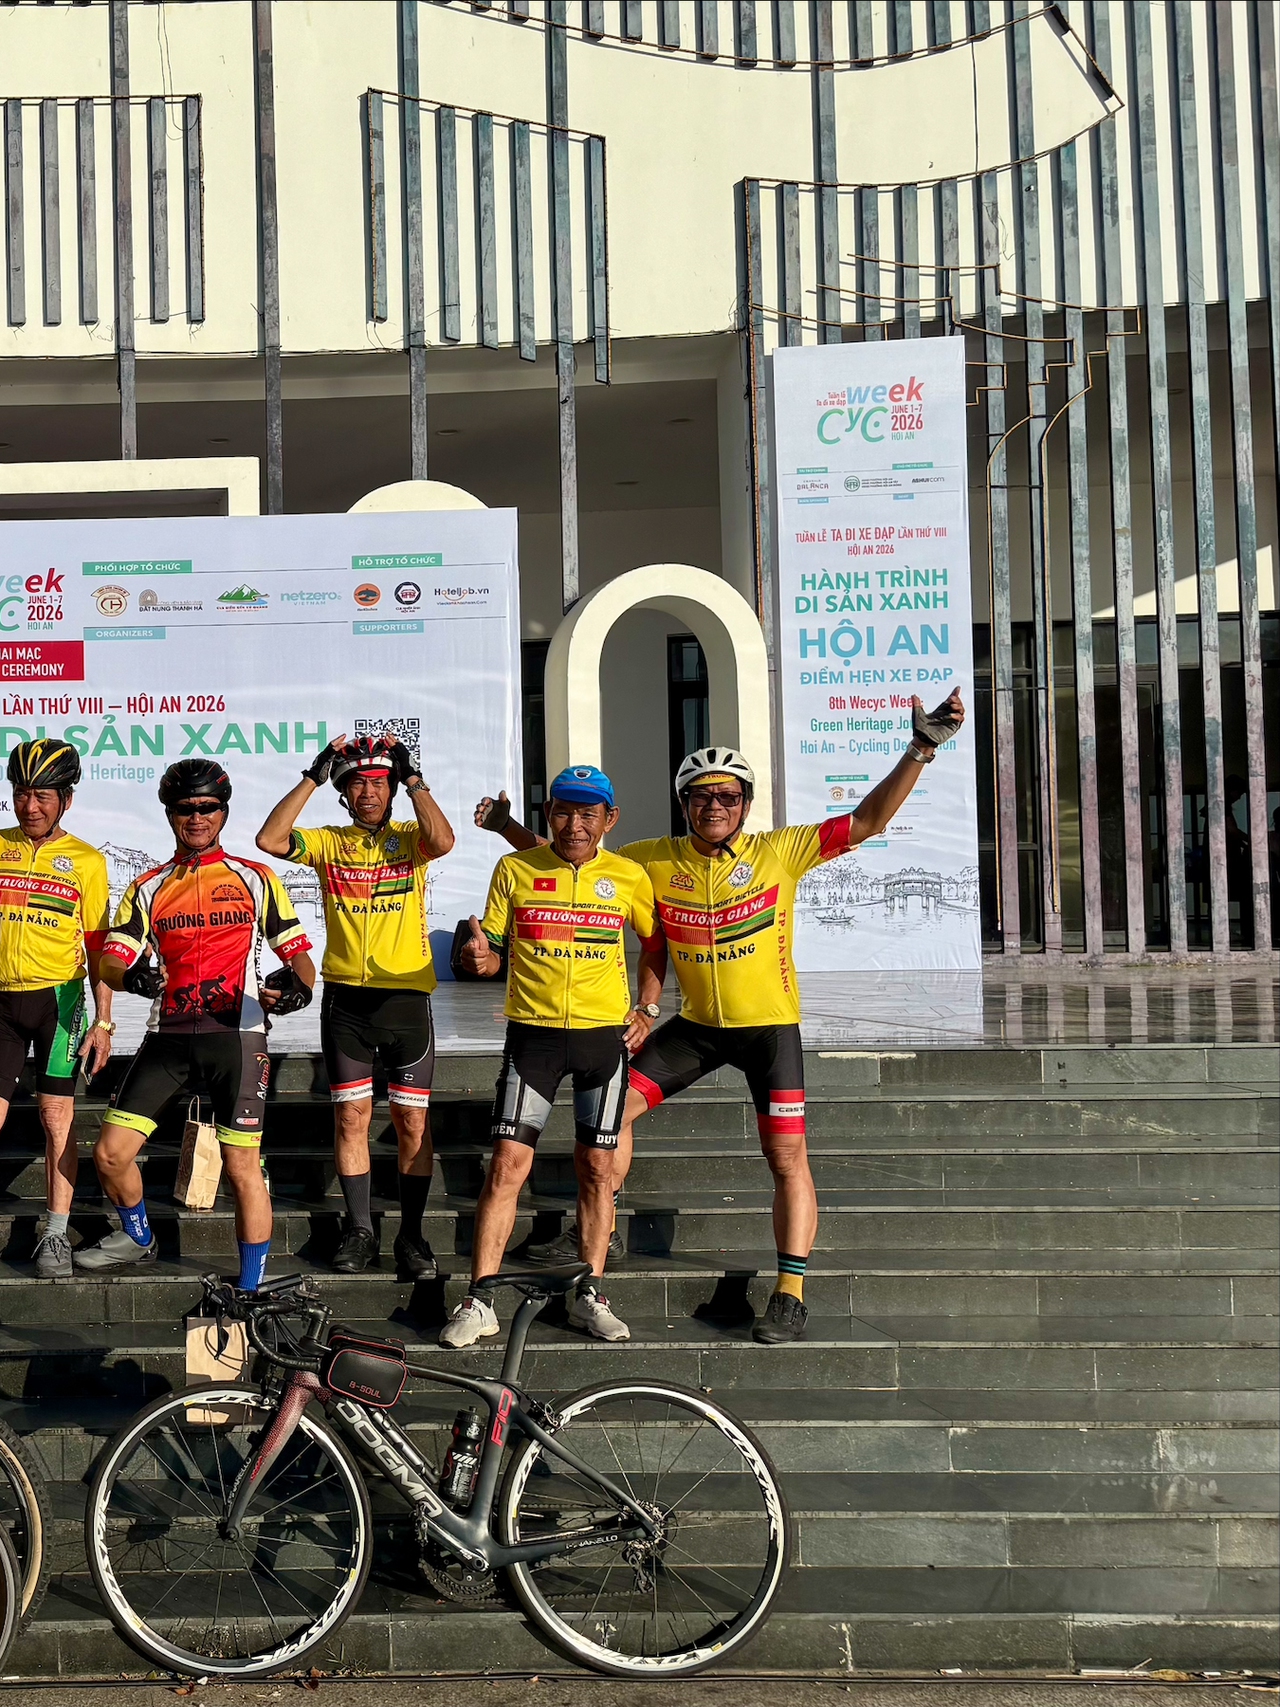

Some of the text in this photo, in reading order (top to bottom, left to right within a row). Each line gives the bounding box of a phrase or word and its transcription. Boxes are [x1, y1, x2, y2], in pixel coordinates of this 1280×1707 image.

[847, 376, 924, 404] week
[891, 414, 923, 431] 2026
[801, 565, 948, 591] HÀNH TRÌNH
[27, 596, 47, 604] JUNE
[795, 589, 948, 614] DI SẢN XANH
[27, 604, 63, 621] 2026
[42, 622, 53, 630] AN
[359, 624, 417, 632] SUPPORTERS
[799, 618, 949, 667] HỘI AN
[16, 647, 42, 662] MẠC
[1, 663, 64, 677] CEREMONY
[799, 666, 953, 687] ĐIỂM HẸN XE ĐẠP
[2, 692, 33, 715] LẦN
[41, 694, 72, 714] THỨ
[77, 697, 104, 714] VIII
[127, 692, 154, 717] HỘI
[159, 696, 181, 713] AN
[187, 694, 226, 713] 2026
[828, 696, 846, 710] 8th
[849, 695, 886, 712] Wecyc
[810, 718, 843, 732] Green
[846, 717, 893, 734] Heritage
[179, 721, 327, 756] XANH
[90, 764, 155, 783] Heritage
[42, 883, 74, 897] GIANG
[536, 910, 621, 927] TRƯỜNG GIANG
[674, 896, 766, 925] TRƯỜNG GIANG
[155, 910, 252, 932] TRƯỜNG GIANG
[282, 940, 303, 953] DUY
[533, 946, 551, 957] TP.
[554, 946, 571, 958] ĐÀ
[677, 950, 693, 962] TP.
[696, 949, 715, 963] ĐÀ
[596, 1134, 617, 1145] DUY
[348, 1380, 381, 1399] B-SOUL
[336, 1400, 443, 1518] DOGMA
